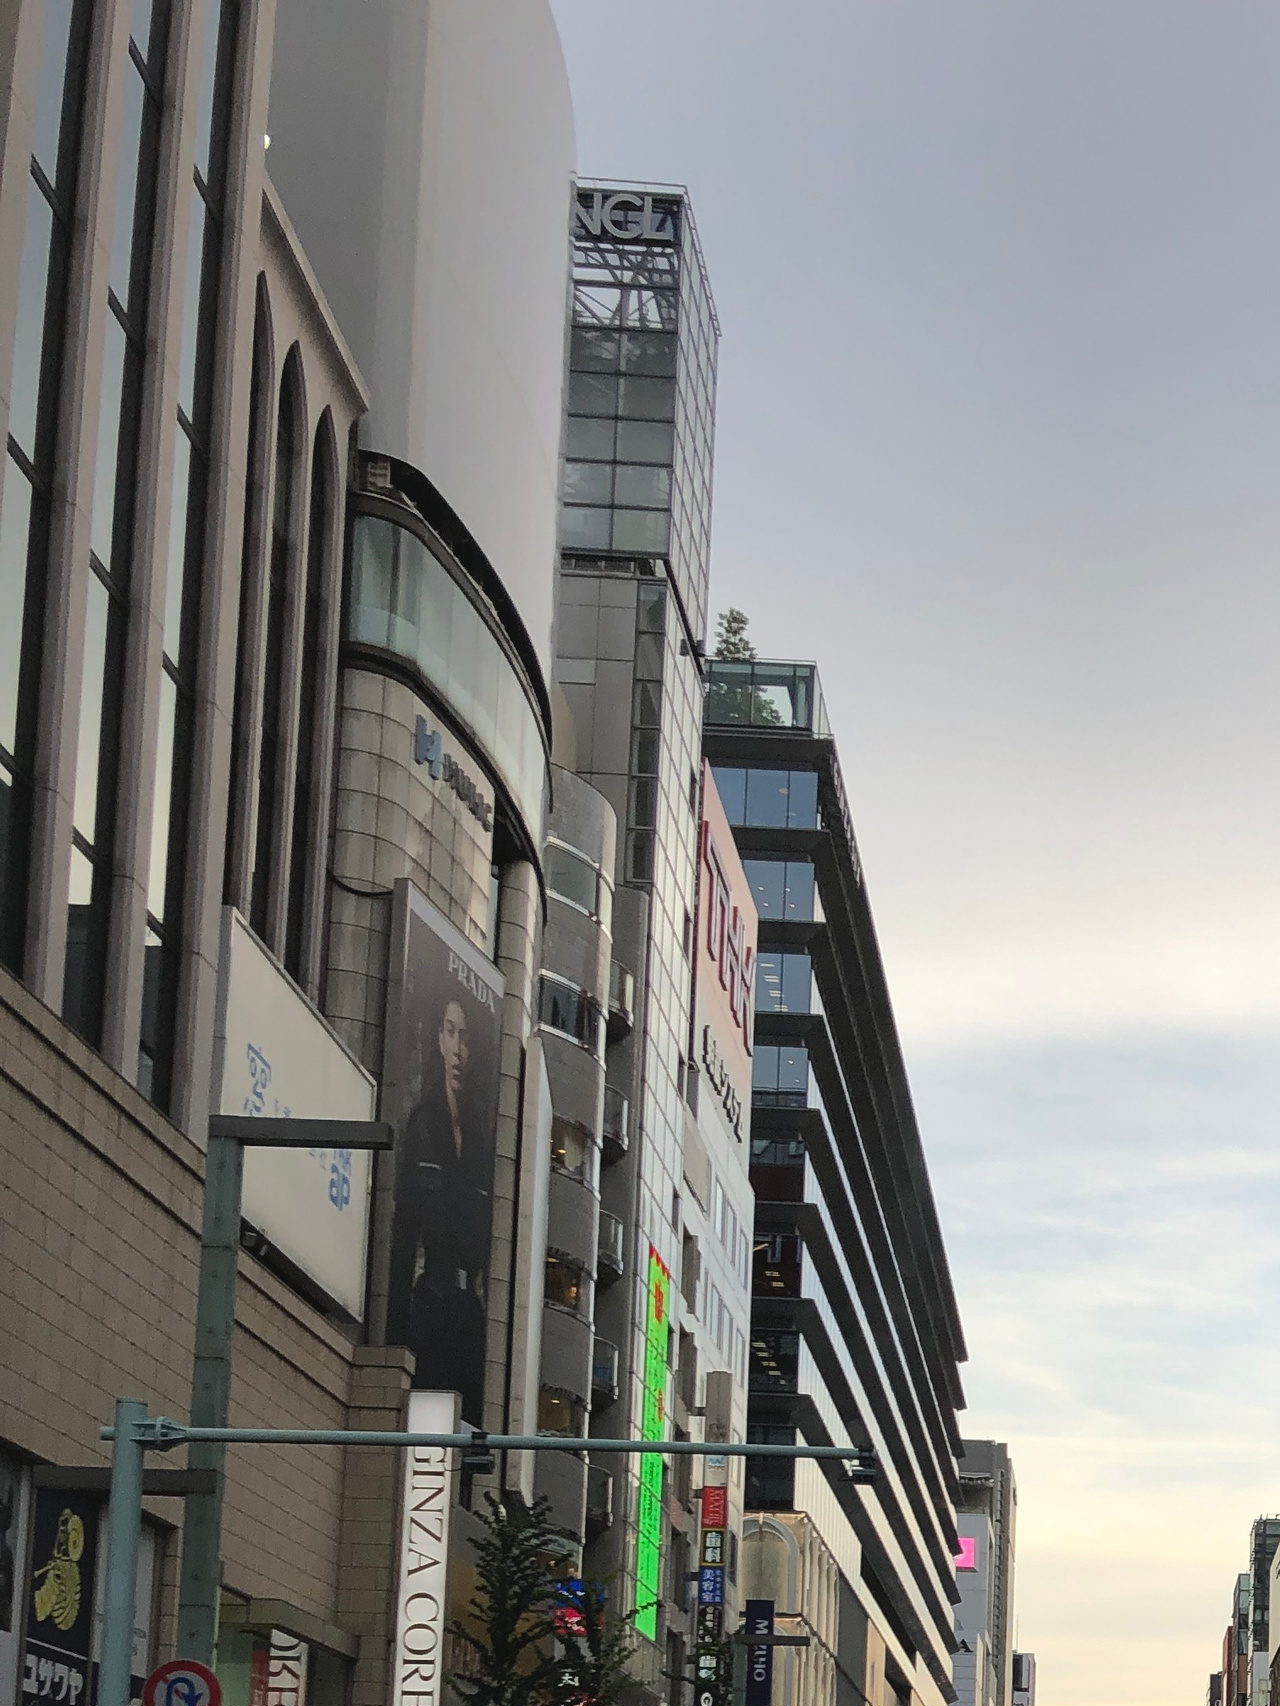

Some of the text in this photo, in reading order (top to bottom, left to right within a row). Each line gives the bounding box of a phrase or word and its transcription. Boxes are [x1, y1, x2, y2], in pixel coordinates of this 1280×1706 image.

[449, 952, 496, 1015] PRADA
[406, 1445, 447, 1577] GINZA
[702, 1569, 715, 1602] 美容室
